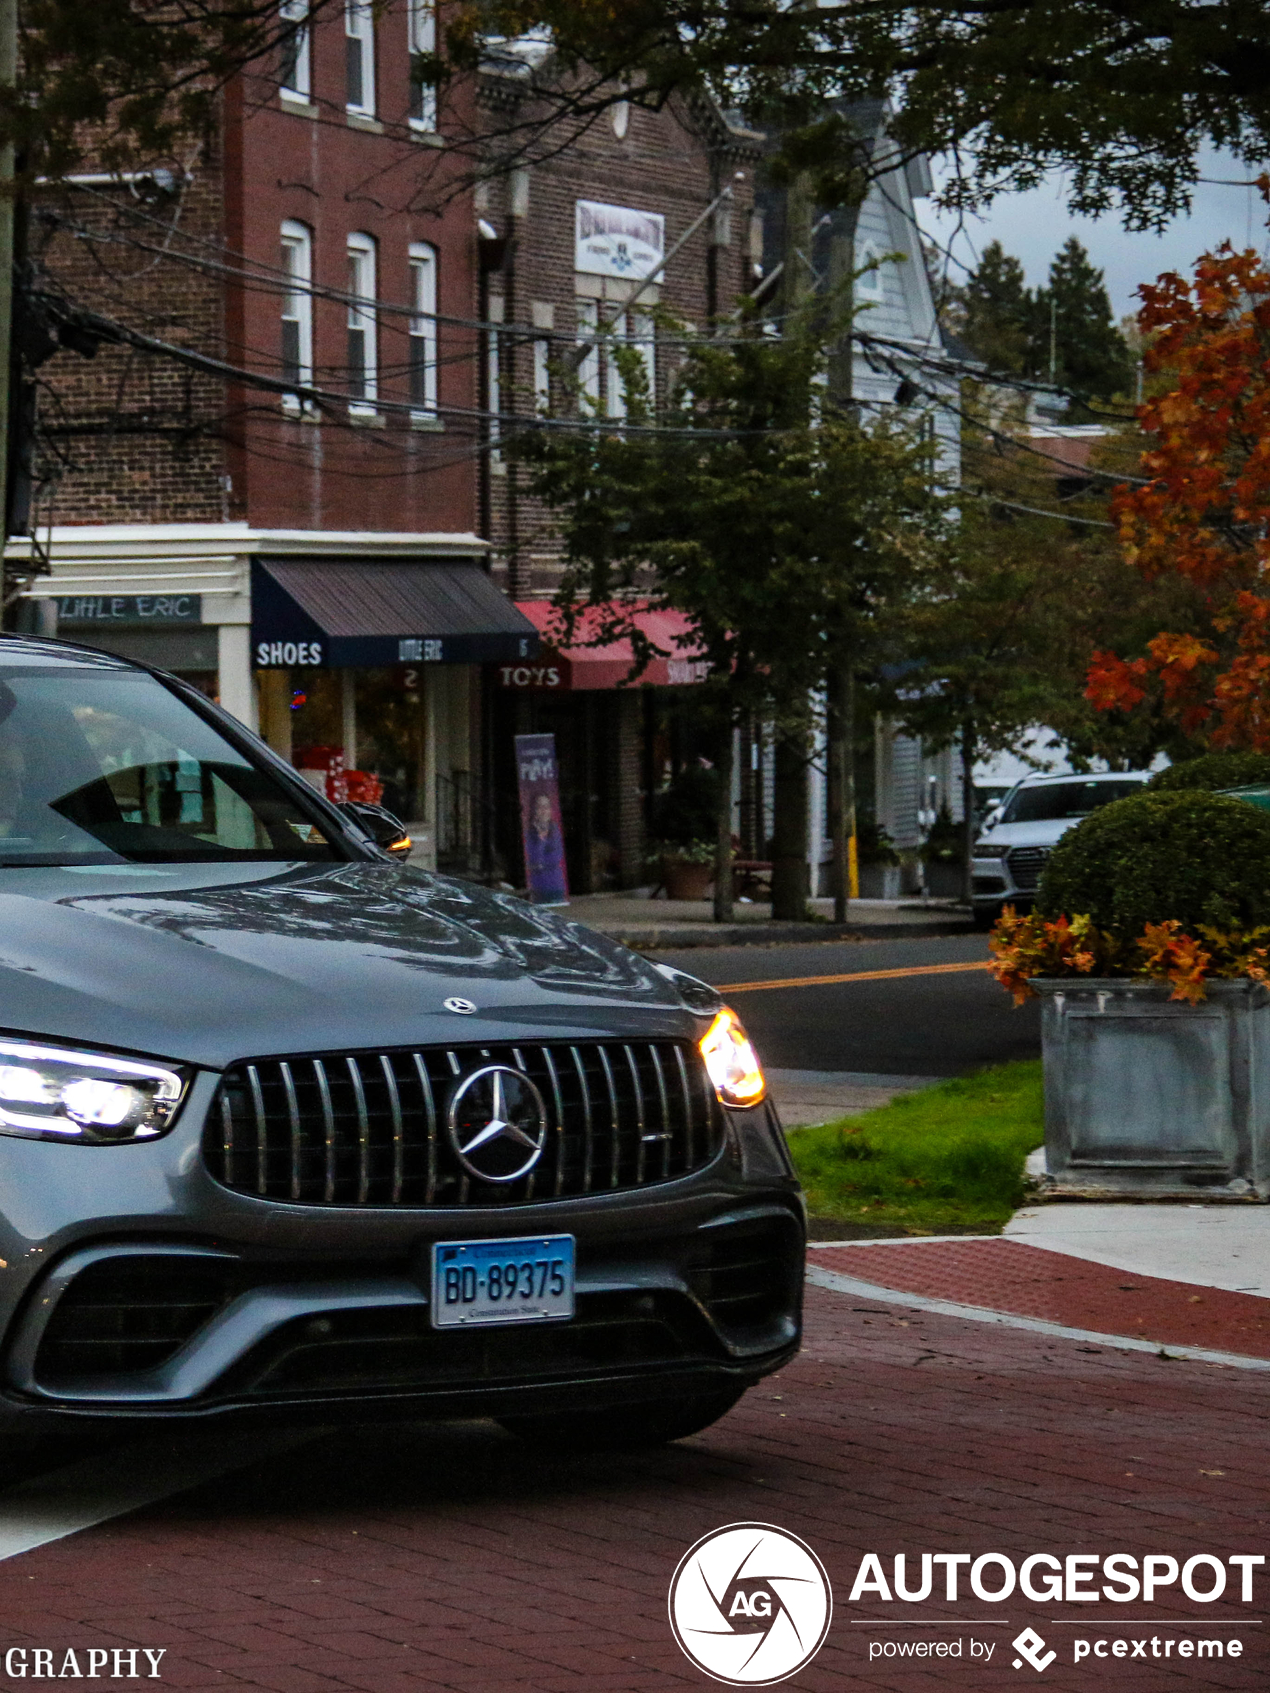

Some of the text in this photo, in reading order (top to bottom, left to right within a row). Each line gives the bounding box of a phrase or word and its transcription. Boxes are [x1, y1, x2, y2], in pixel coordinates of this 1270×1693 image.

[59, 596, 189, 618] LITTLE ERIC
[257, 642, 322, 665] SHOES
[500, 667, 560, 686] TOYS
